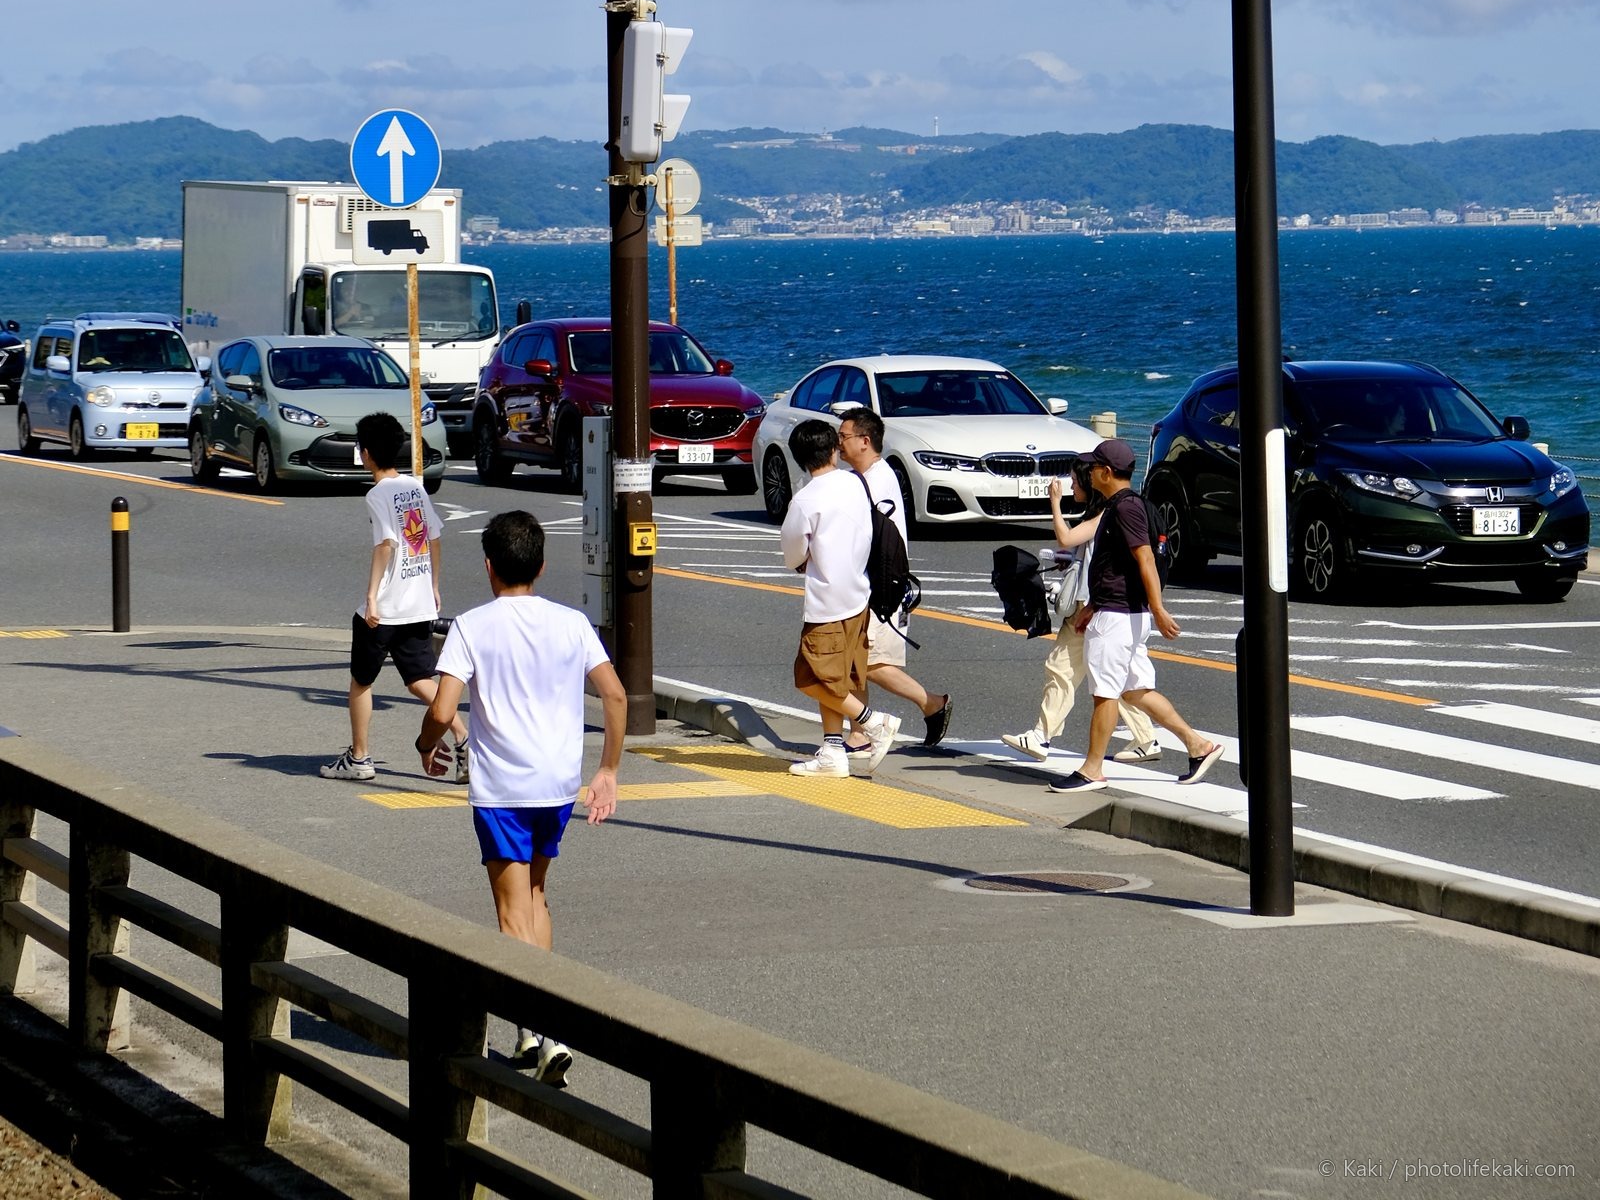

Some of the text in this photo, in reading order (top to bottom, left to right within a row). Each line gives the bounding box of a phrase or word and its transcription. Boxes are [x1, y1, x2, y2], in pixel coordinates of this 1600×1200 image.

[687, 452, 711, 462] 33-07
[1028, 485, 1050, 496] 10-0
[1483, 520, 1517, 532] 81-36
